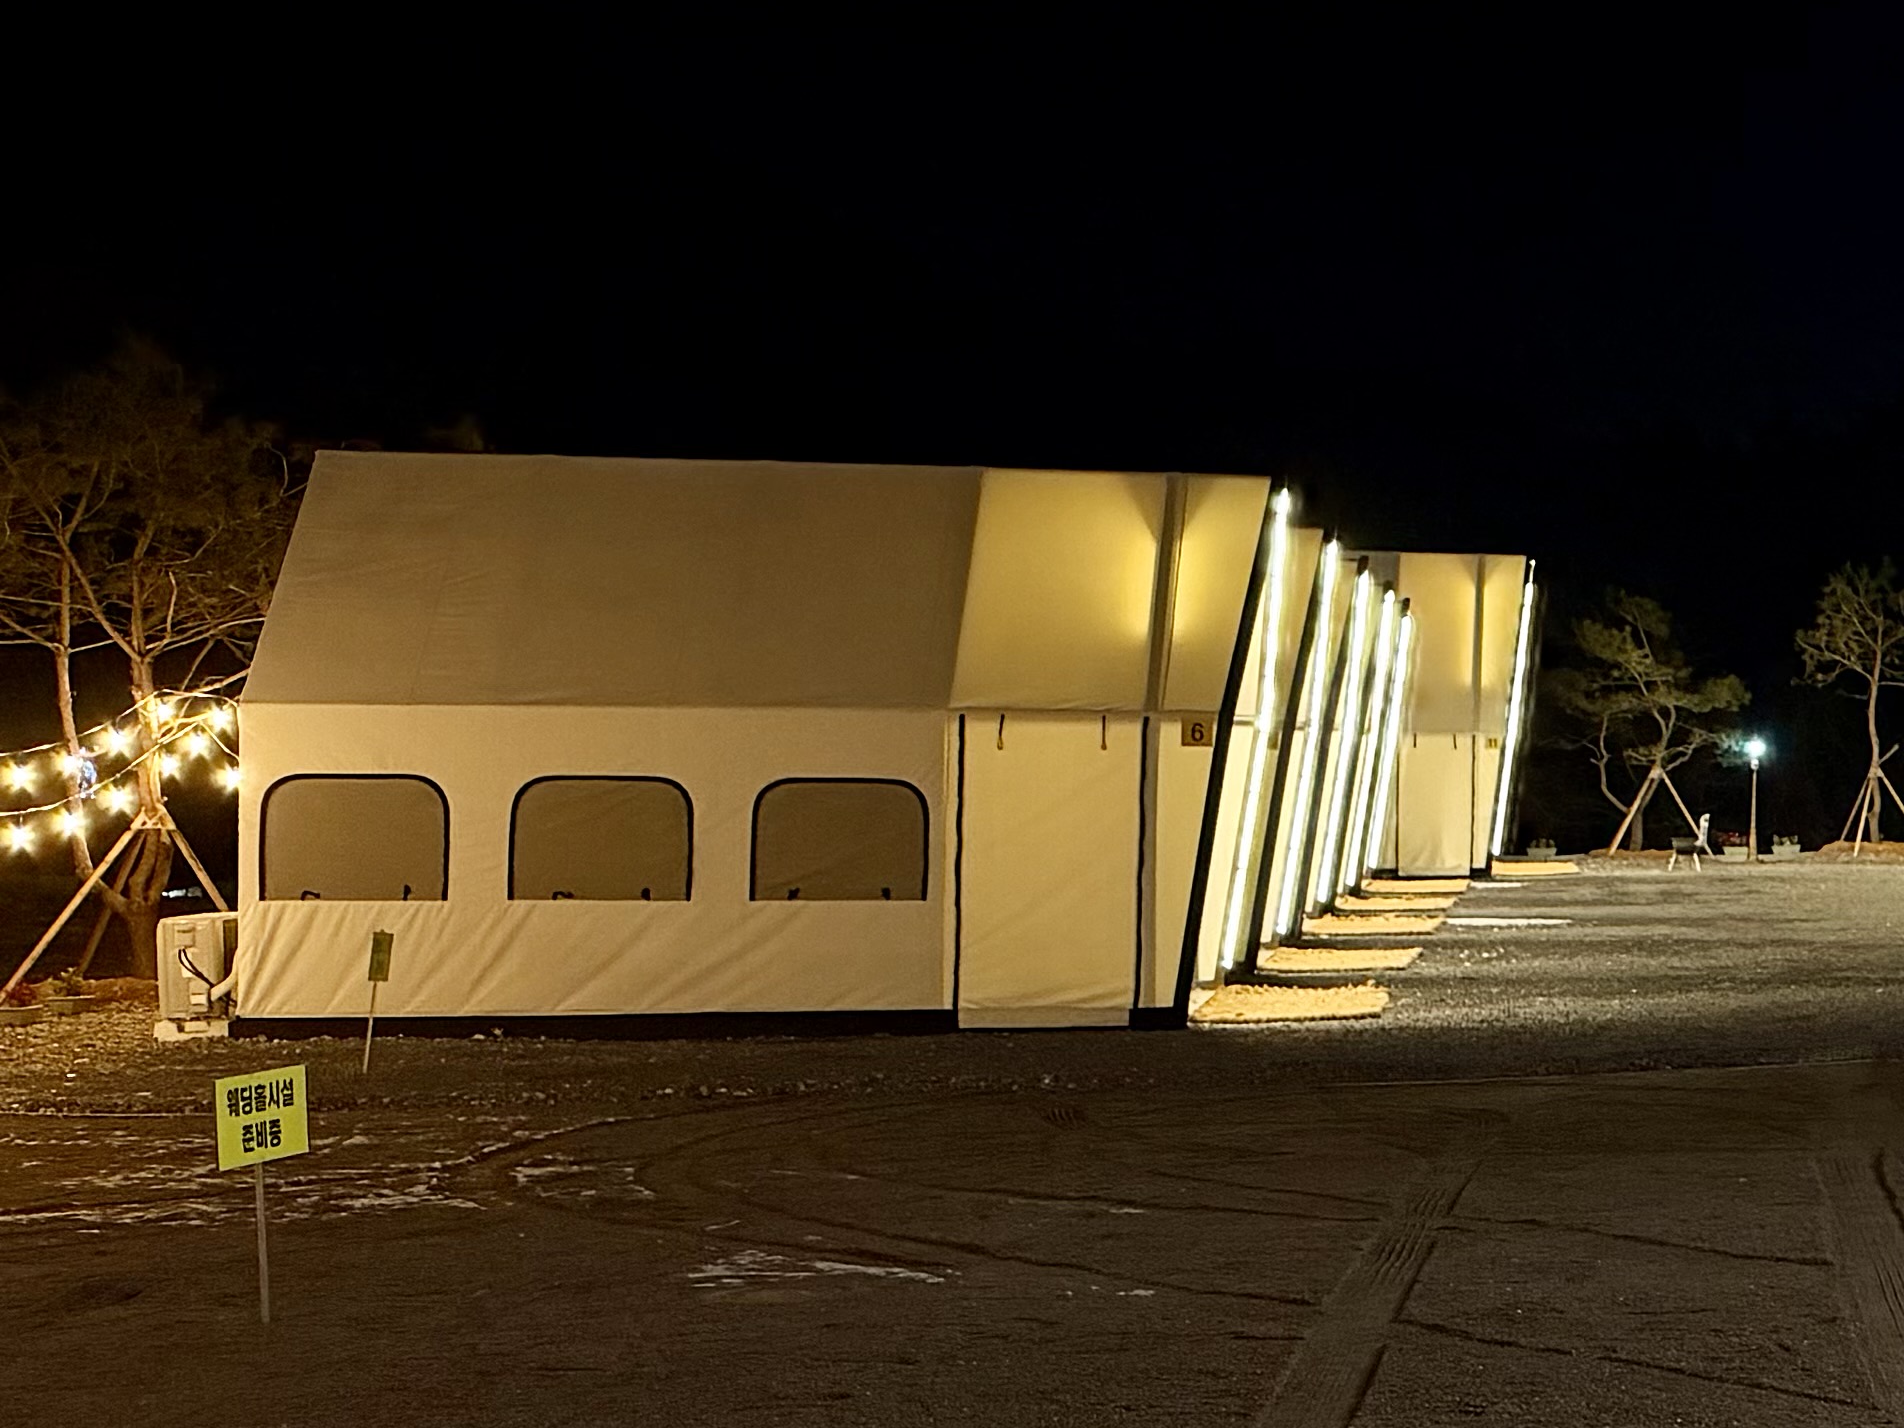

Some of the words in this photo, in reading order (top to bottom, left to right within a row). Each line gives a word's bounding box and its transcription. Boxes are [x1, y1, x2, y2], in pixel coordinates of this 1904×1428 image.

[1191, 722, 1204, 743] 6
[226, 1077, 294, 1117] 웨딩홀시설
[241, 1118, 282, 1153] 준비중
